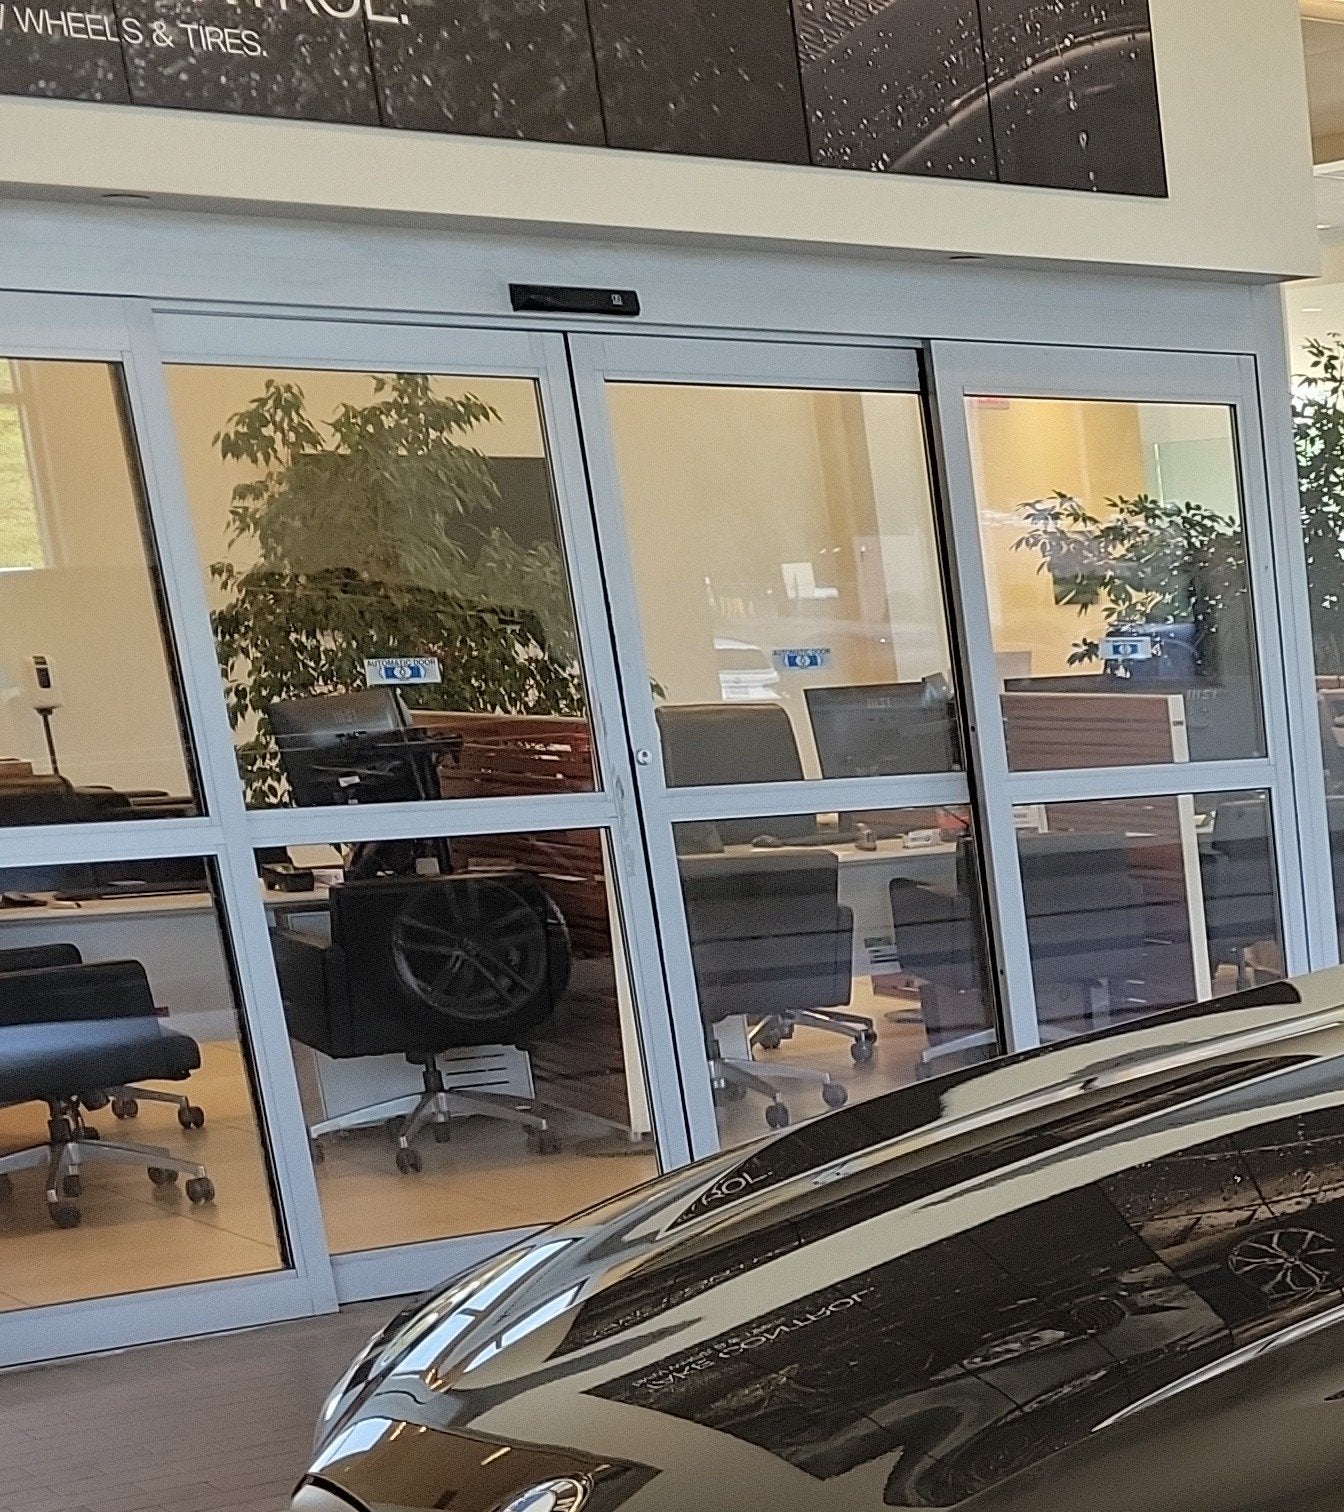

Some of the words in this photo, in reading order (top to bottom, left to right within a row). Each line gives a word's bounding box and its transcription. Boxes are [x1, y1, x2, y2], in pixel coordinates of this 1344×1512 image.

[12, 5, 144, 45] WHEELS
[151, 20, 176, 49] &
[177, 20, 268, 57] TIRES.
[367, 659, 411, 667] AUTOMATIC
[413, 658, 436, 666] DOOR
